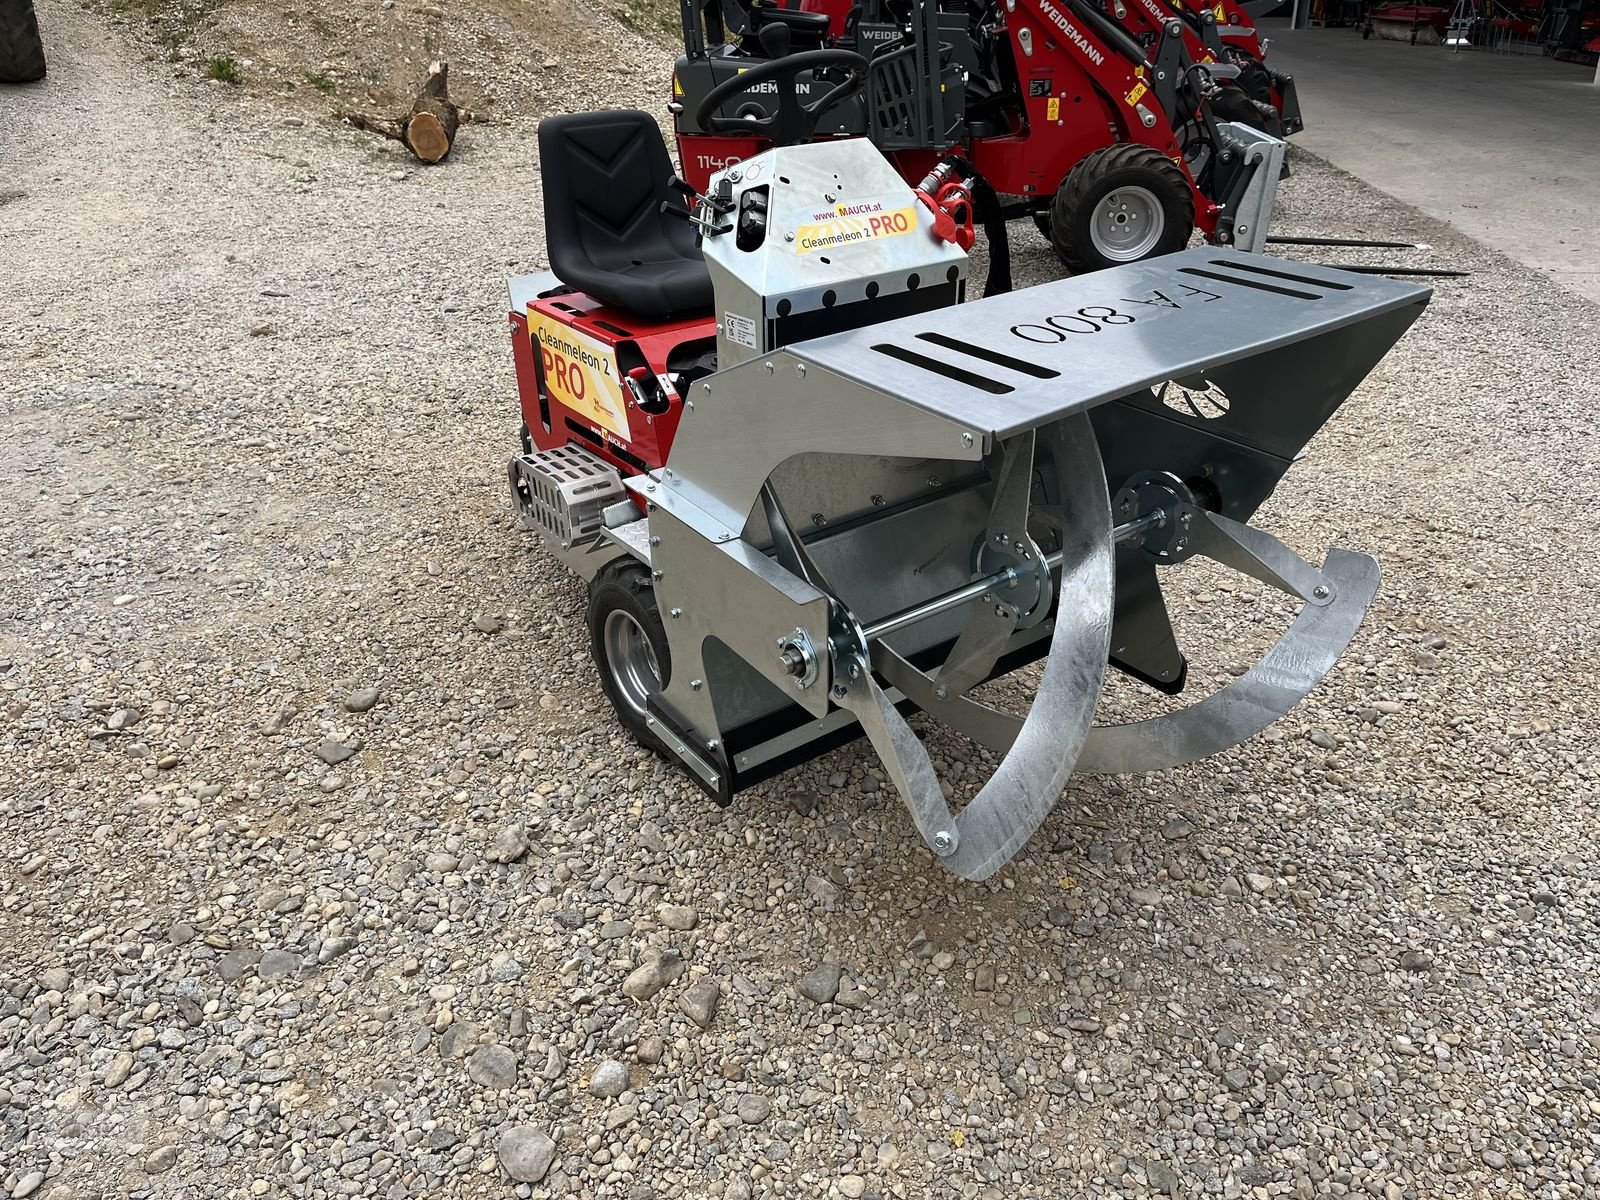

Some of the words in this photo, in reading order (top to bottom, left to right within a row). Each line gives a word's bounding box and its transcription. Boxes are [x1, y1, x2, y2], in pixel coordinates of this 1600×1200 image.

[862, 30, 904, 40] WEIDE
[1039, 0, 1104, 66] WEIDEMANN
[801, 231, 863, 249] Cleanmeleon
[863, 228, 871, 237] 2
[868, 213, 908, 237] PRO
[1009, 306, 1136, 344] 800
[538, 326, 600, 371] Cleanmeleon
[602, 357, 610, 376] 2
[541, 347, 585, 400] PRO
